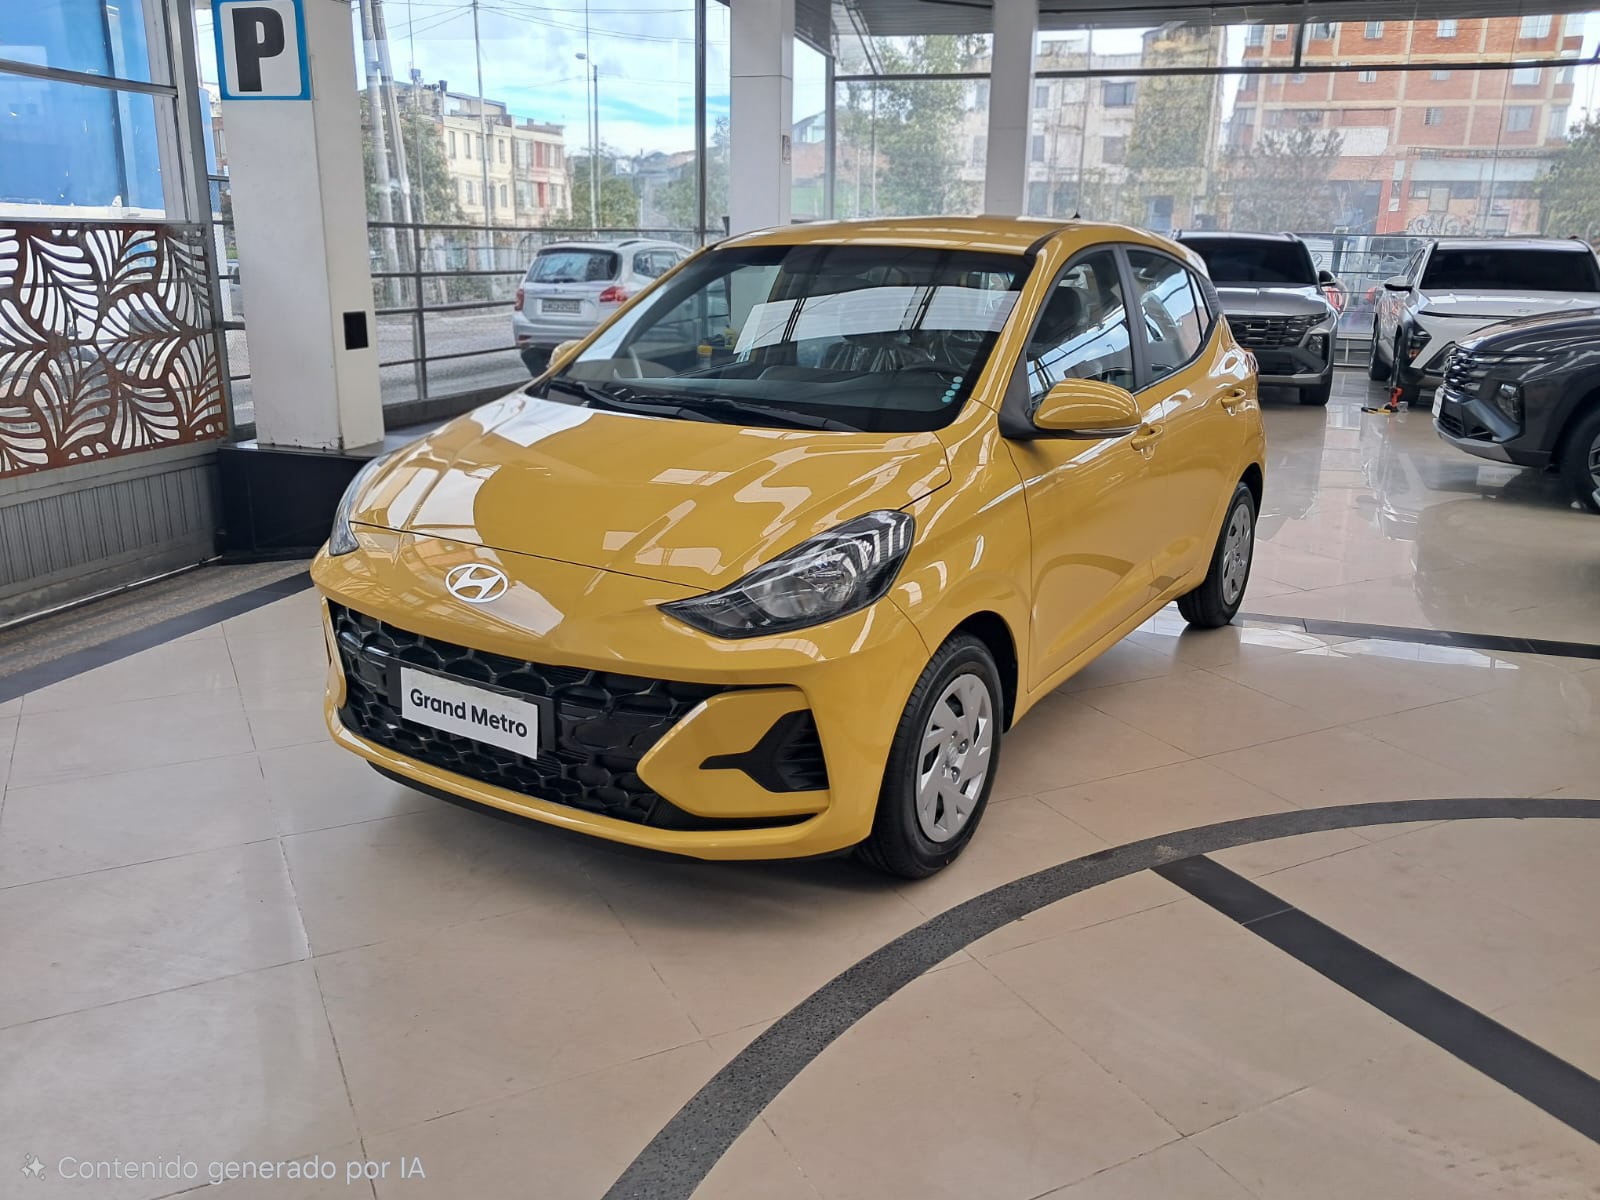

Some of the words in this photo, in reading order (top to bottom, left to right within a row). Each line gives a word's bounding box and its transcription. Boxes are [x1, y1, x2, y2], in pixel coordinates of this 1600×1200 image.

[232, 7, 285, 92] P
[410, 688, 466, 720] Grand
[471, 705, 528, 738] Metro
